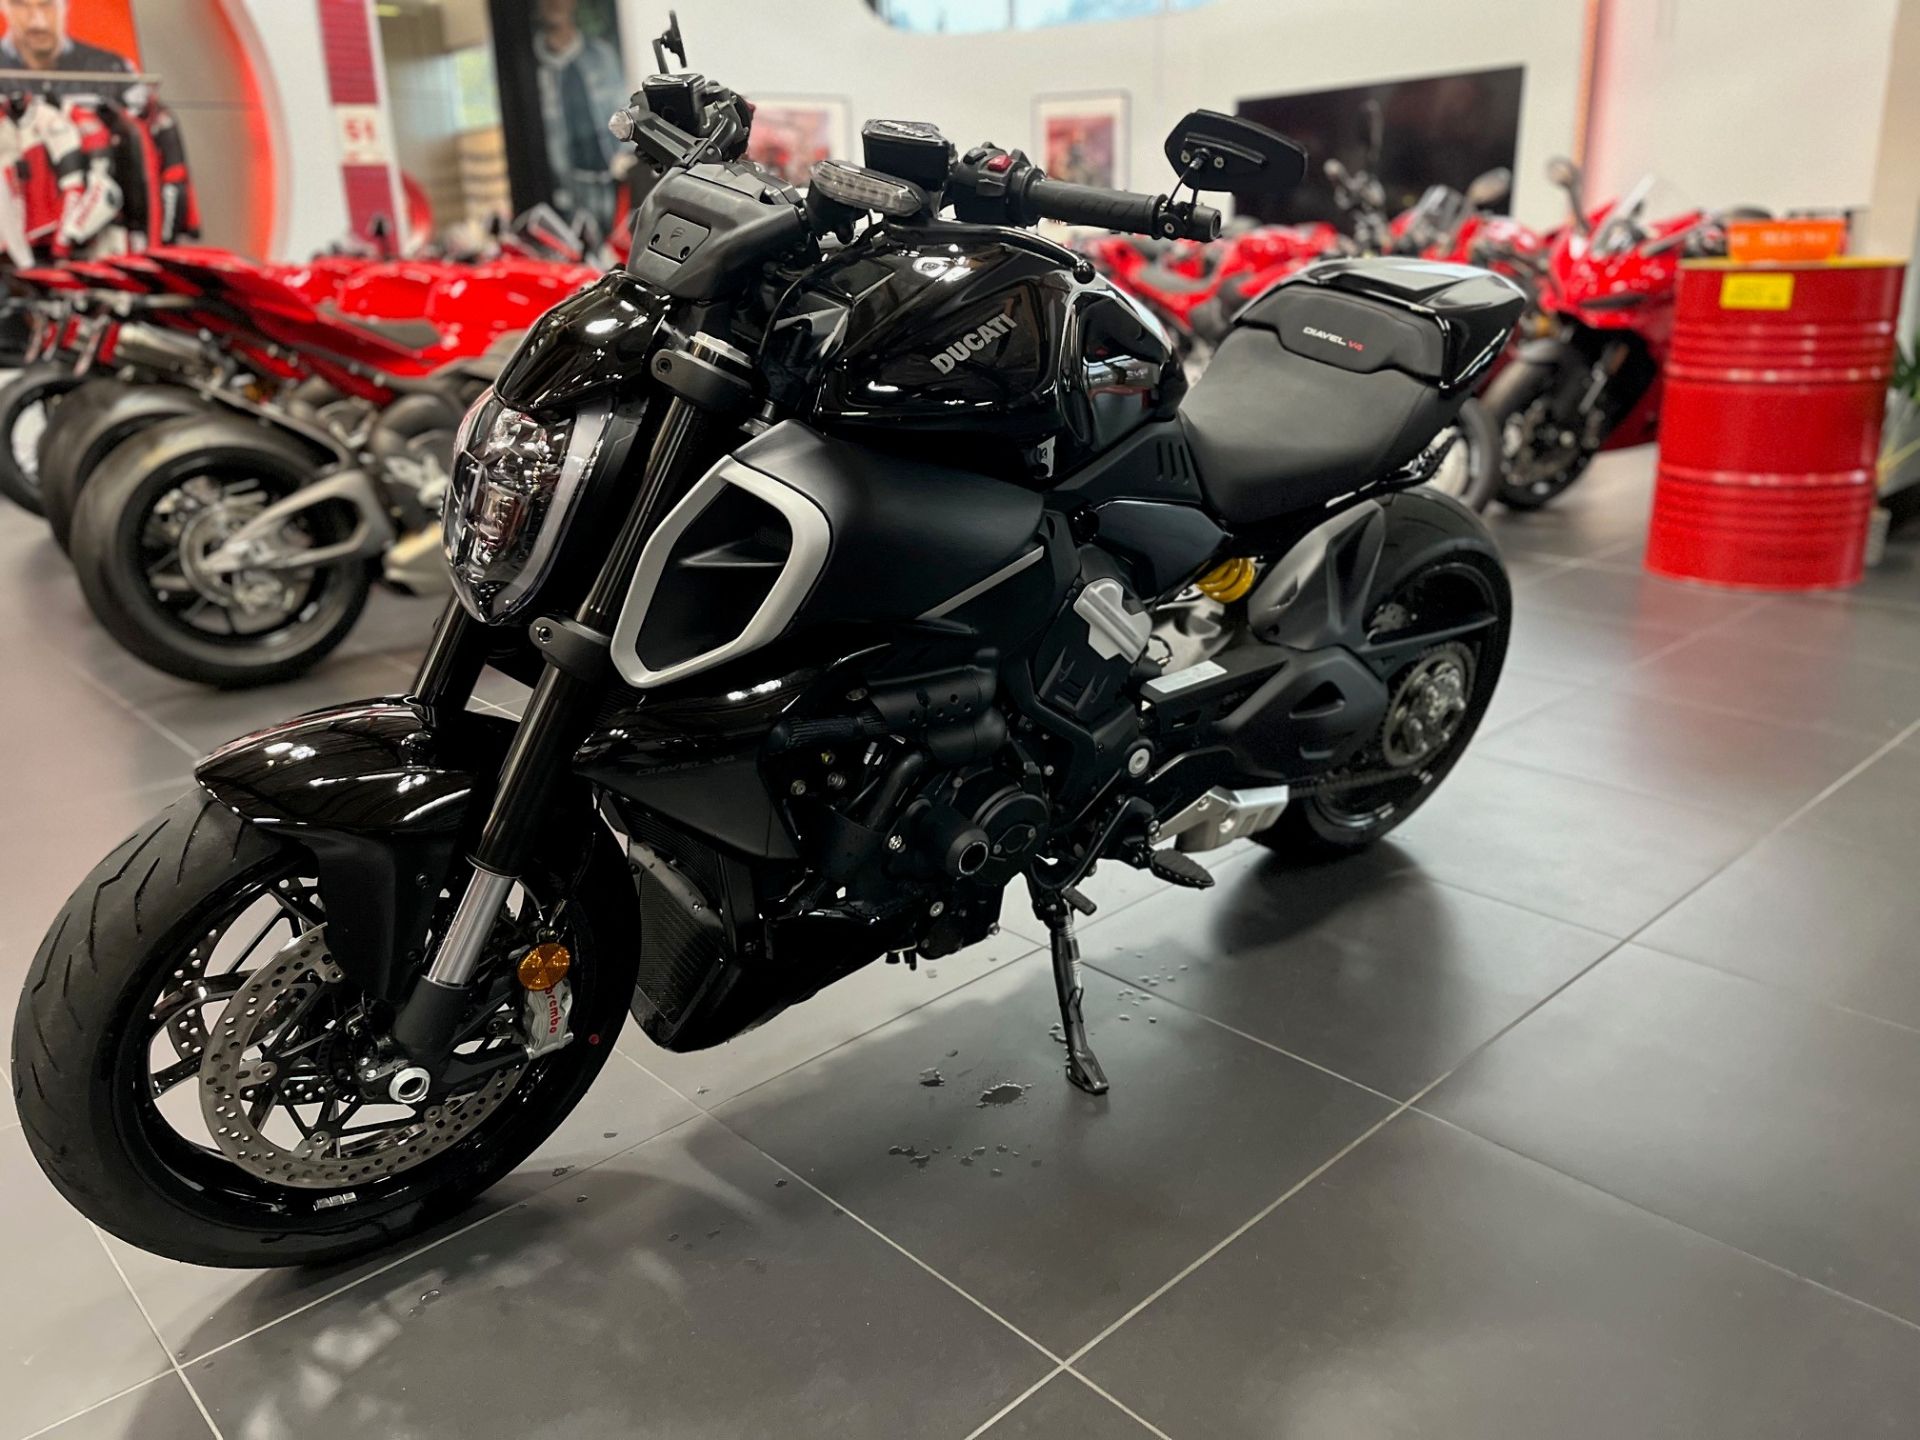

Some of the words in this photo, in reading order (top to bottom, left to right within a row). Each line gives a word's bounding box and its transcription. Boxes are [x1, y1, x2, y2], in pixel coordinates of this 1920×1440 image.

[929, 312, 1018, 375] DUCATI
[1302, 326, 1347, 347] DIAVEL
[543, 985, 562, 1034] brembo
